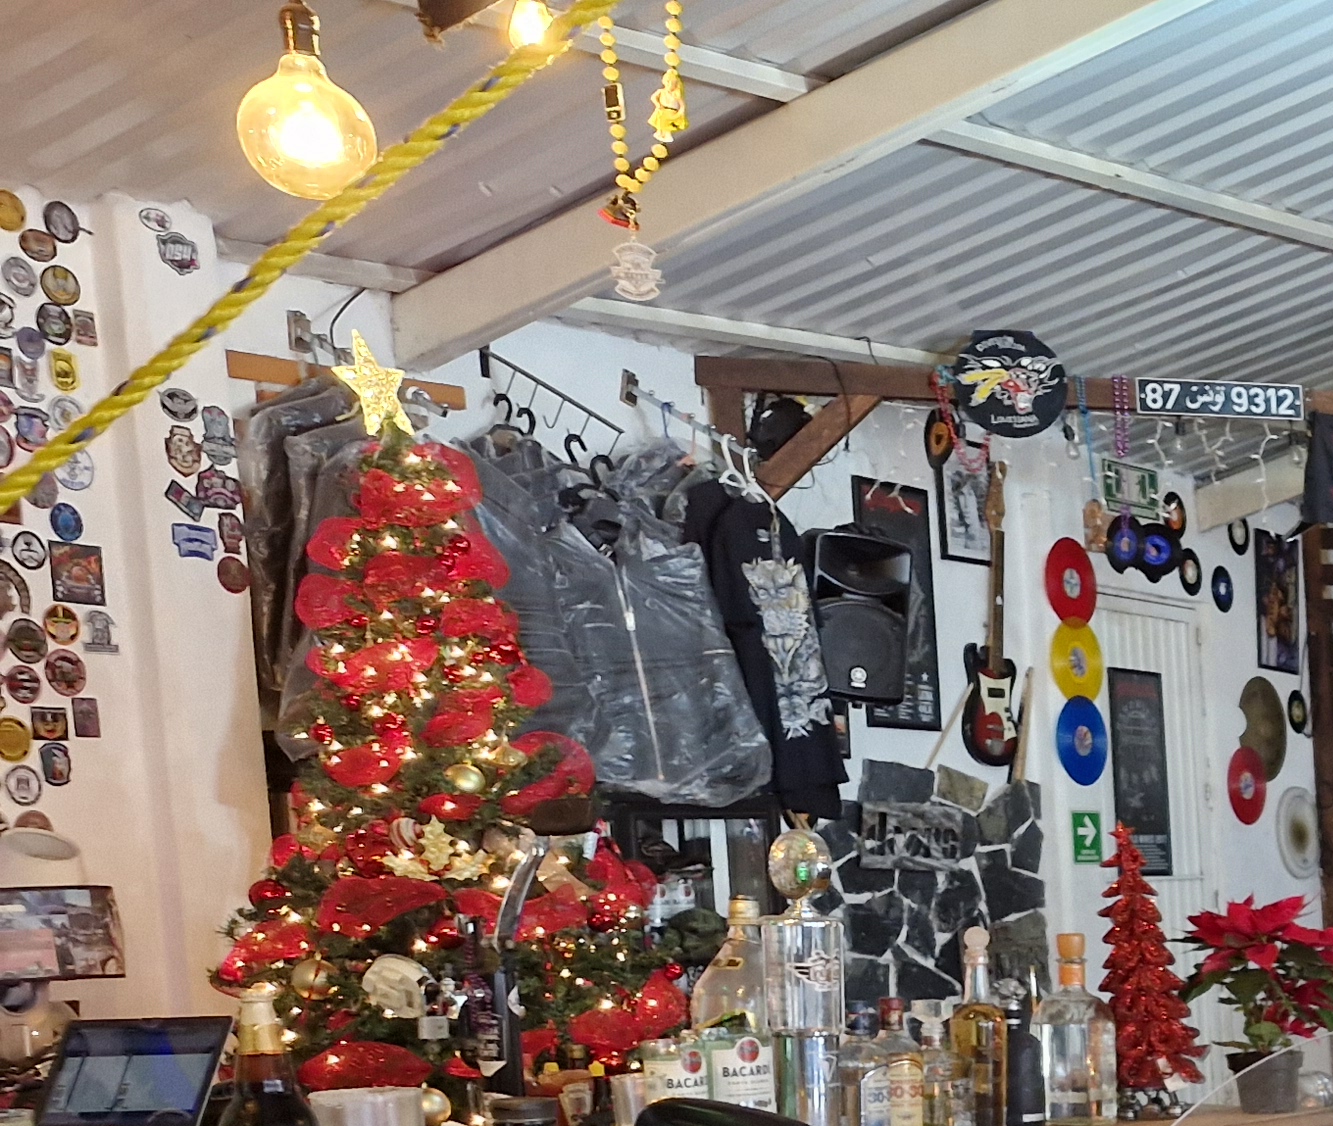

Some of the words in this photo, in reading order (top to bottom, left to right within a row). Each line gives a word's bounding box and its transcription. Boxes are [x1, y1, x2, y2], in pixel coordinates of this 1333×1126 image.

[1145, 382, 1181, 410] 87
[1230, 385, 1296, 416] 9312
[721, 1064, 771, 1078] BACARDI
[666, 1075, 708, 1090] BACAR
